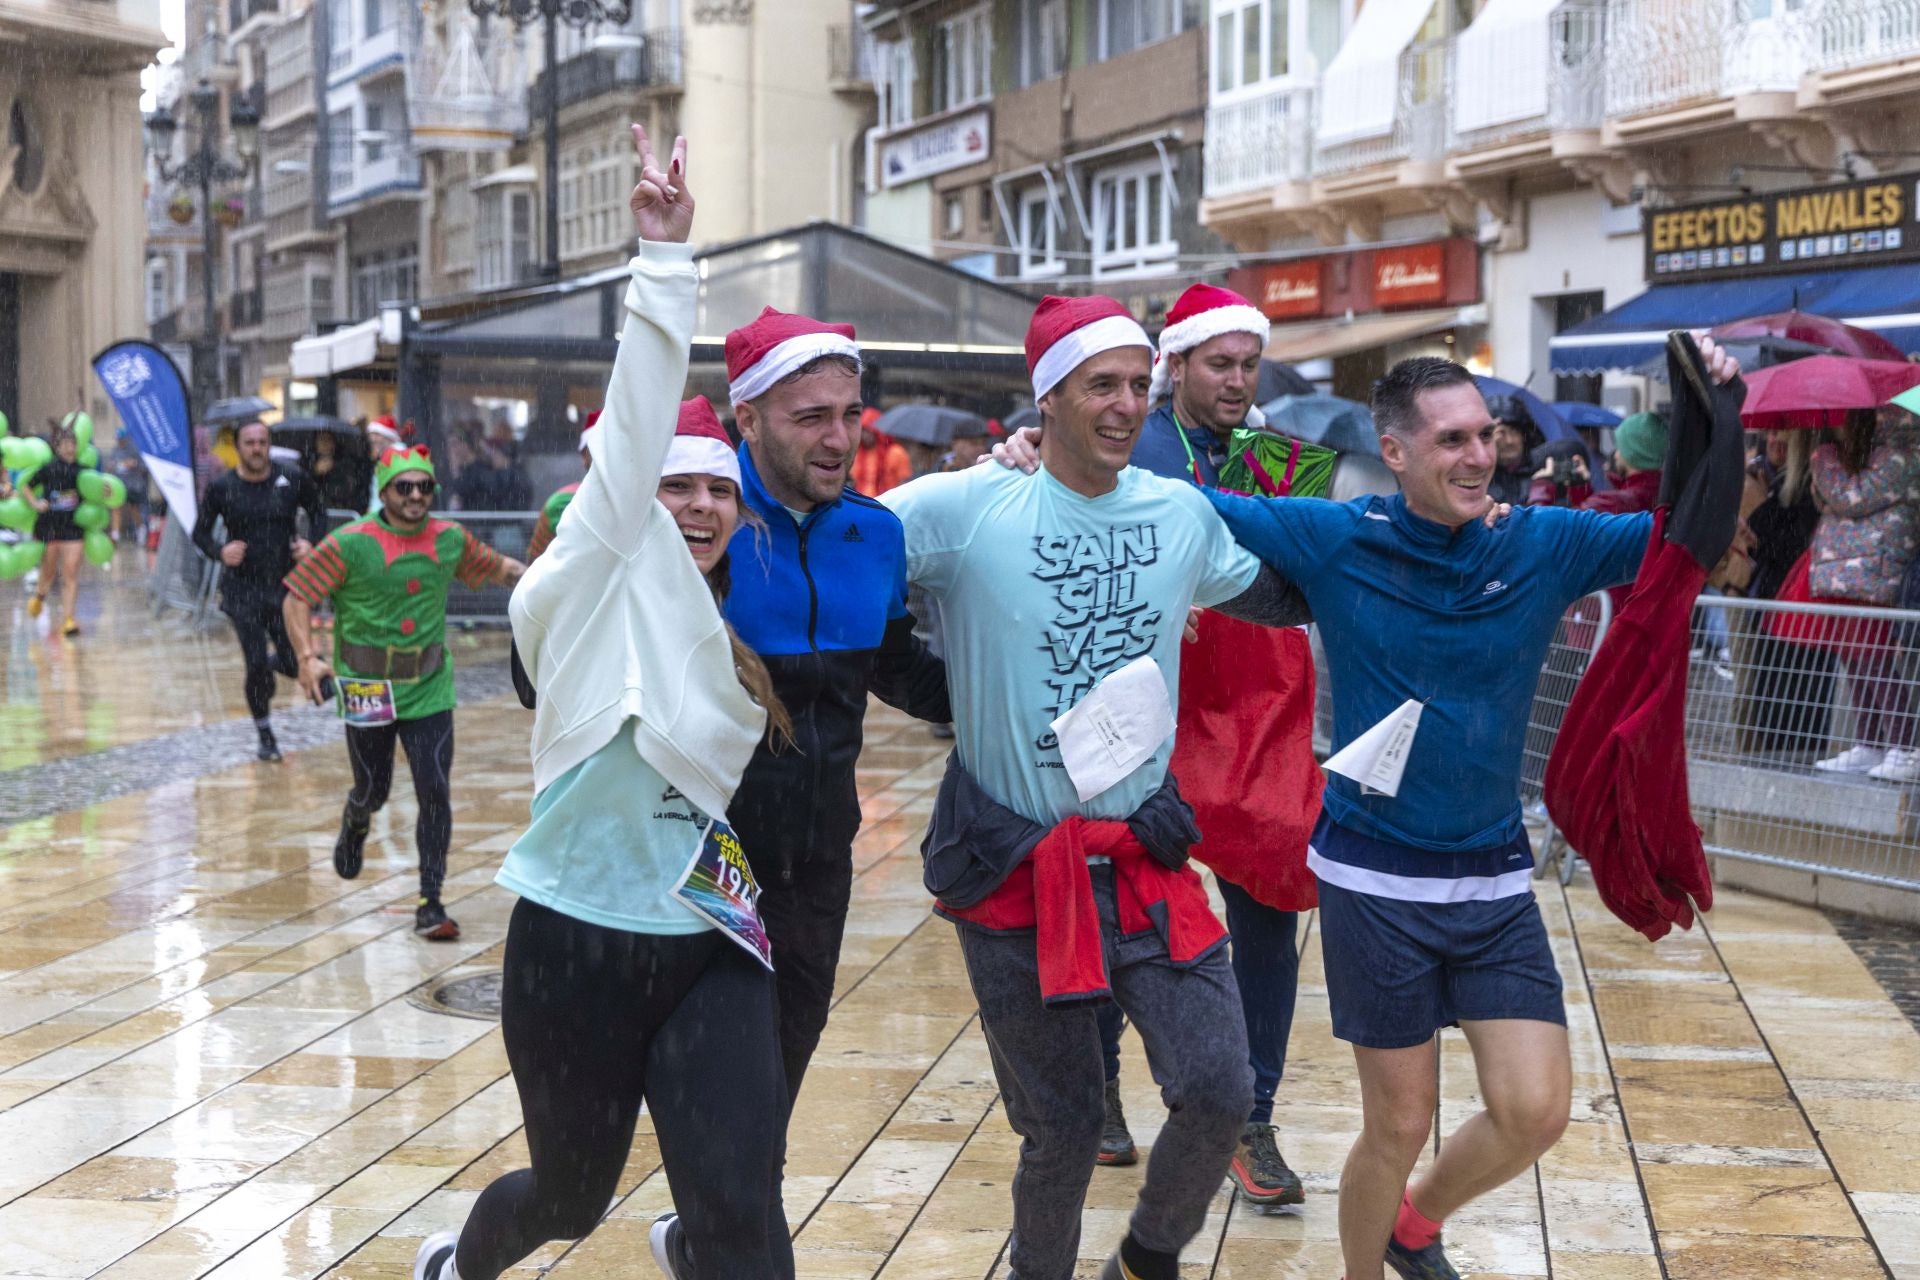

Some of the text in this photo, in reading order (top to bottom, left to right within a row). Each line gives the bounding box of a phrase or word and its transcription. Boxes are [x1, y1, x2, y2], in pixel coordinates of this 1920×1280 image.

[1653, 183, 1902, 250] EFECTOS NAVALES
[1030, 525, 1160, 582] SAN
[1050, 571, 1149, 630] SIL
[1037, 611, 1161, 674] VES
[720, 834, 743, 857] SAN
